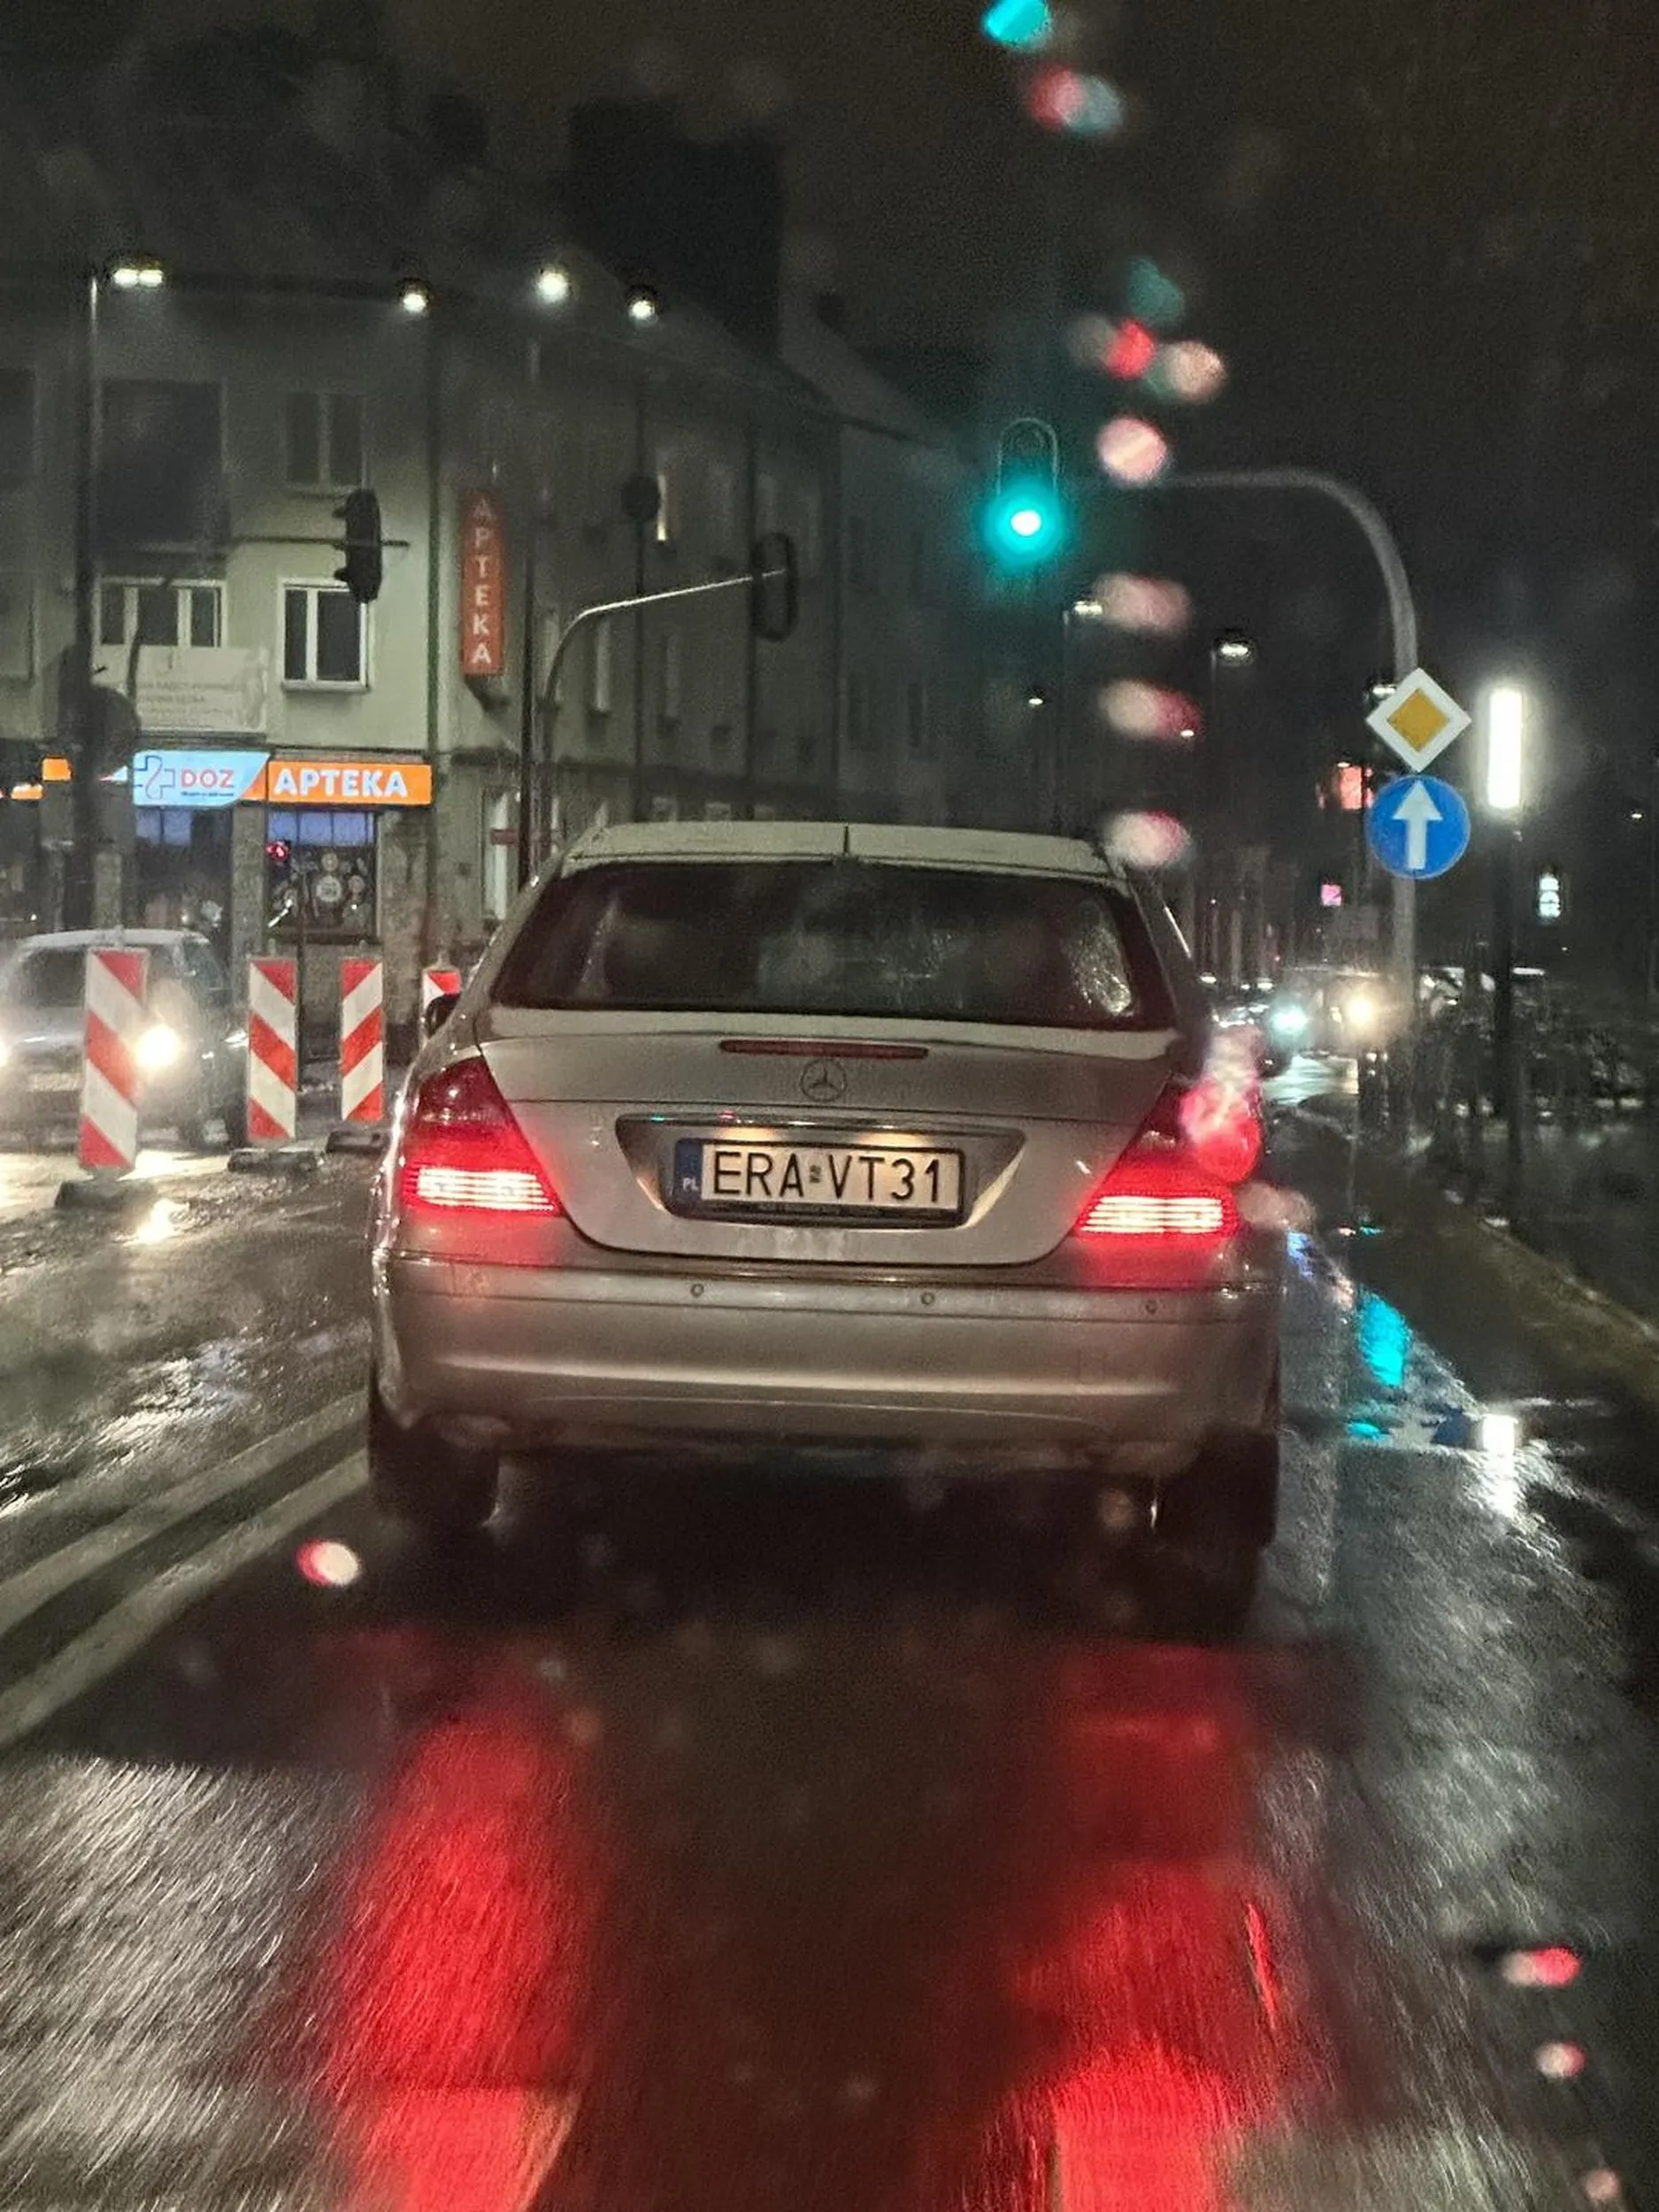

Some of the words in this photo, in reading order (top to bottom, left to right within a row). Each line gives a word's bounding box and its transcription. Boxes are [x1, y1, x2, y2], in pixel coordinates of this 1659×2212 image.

[472, 495, 492, 664] APTEKA
[180, 769, 234, 787] DOZ
[274, 767, 409, 798] APTEKA
[682, 1177, 698, 1191] PL
[714, 1151, 804, 1197] ERA
[828, 1155, 940, 1203] VT31
